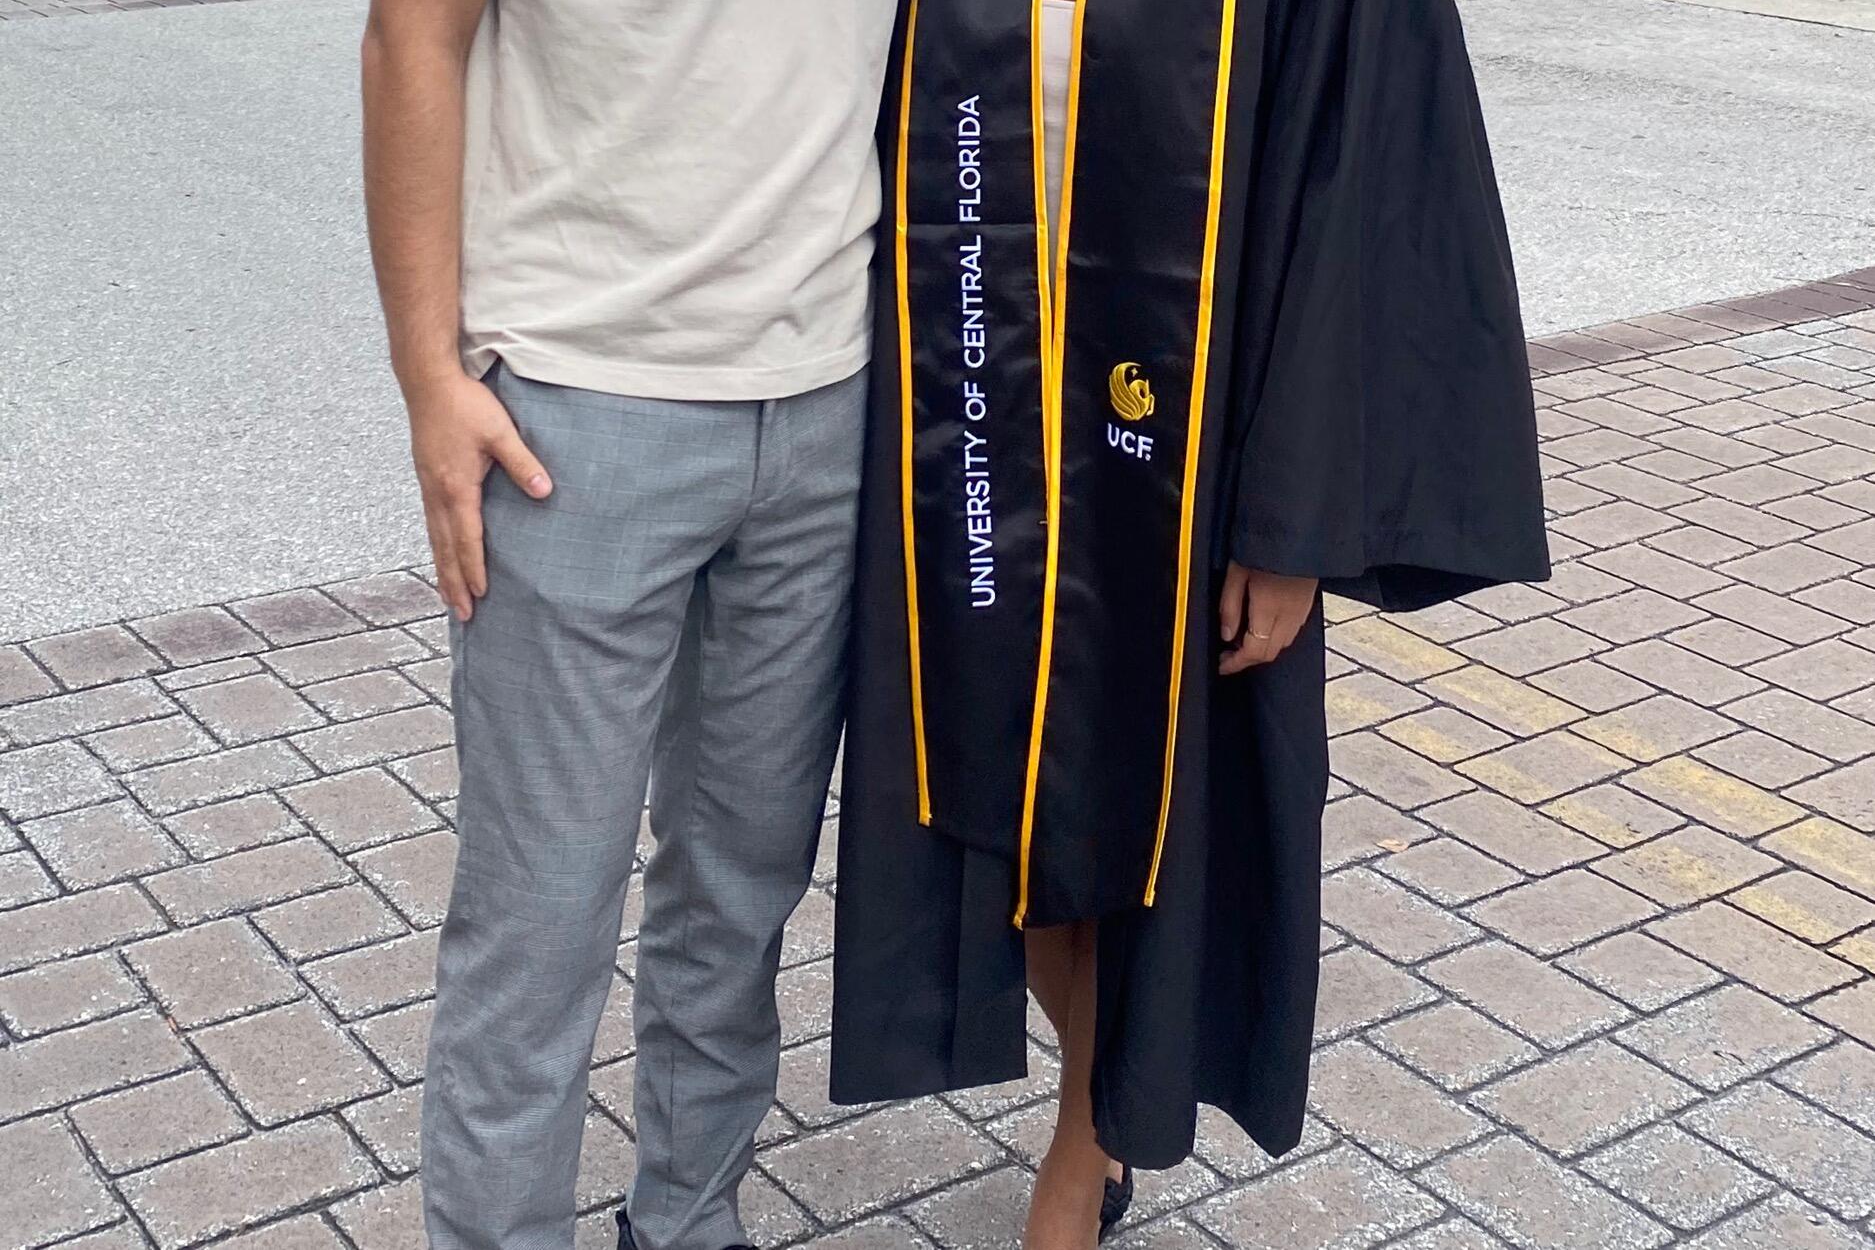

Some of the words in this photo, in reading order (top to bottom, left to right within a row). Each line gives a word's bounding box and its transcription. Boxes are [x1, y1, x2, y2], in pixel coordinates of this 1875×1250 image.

[957, 94, 981, 222] FLORIDA
[959, 235, 986, 368] CENTRAL
[963, 381, 987, 421] OF
[963, 430, 996, 608] UNIVERSITY
